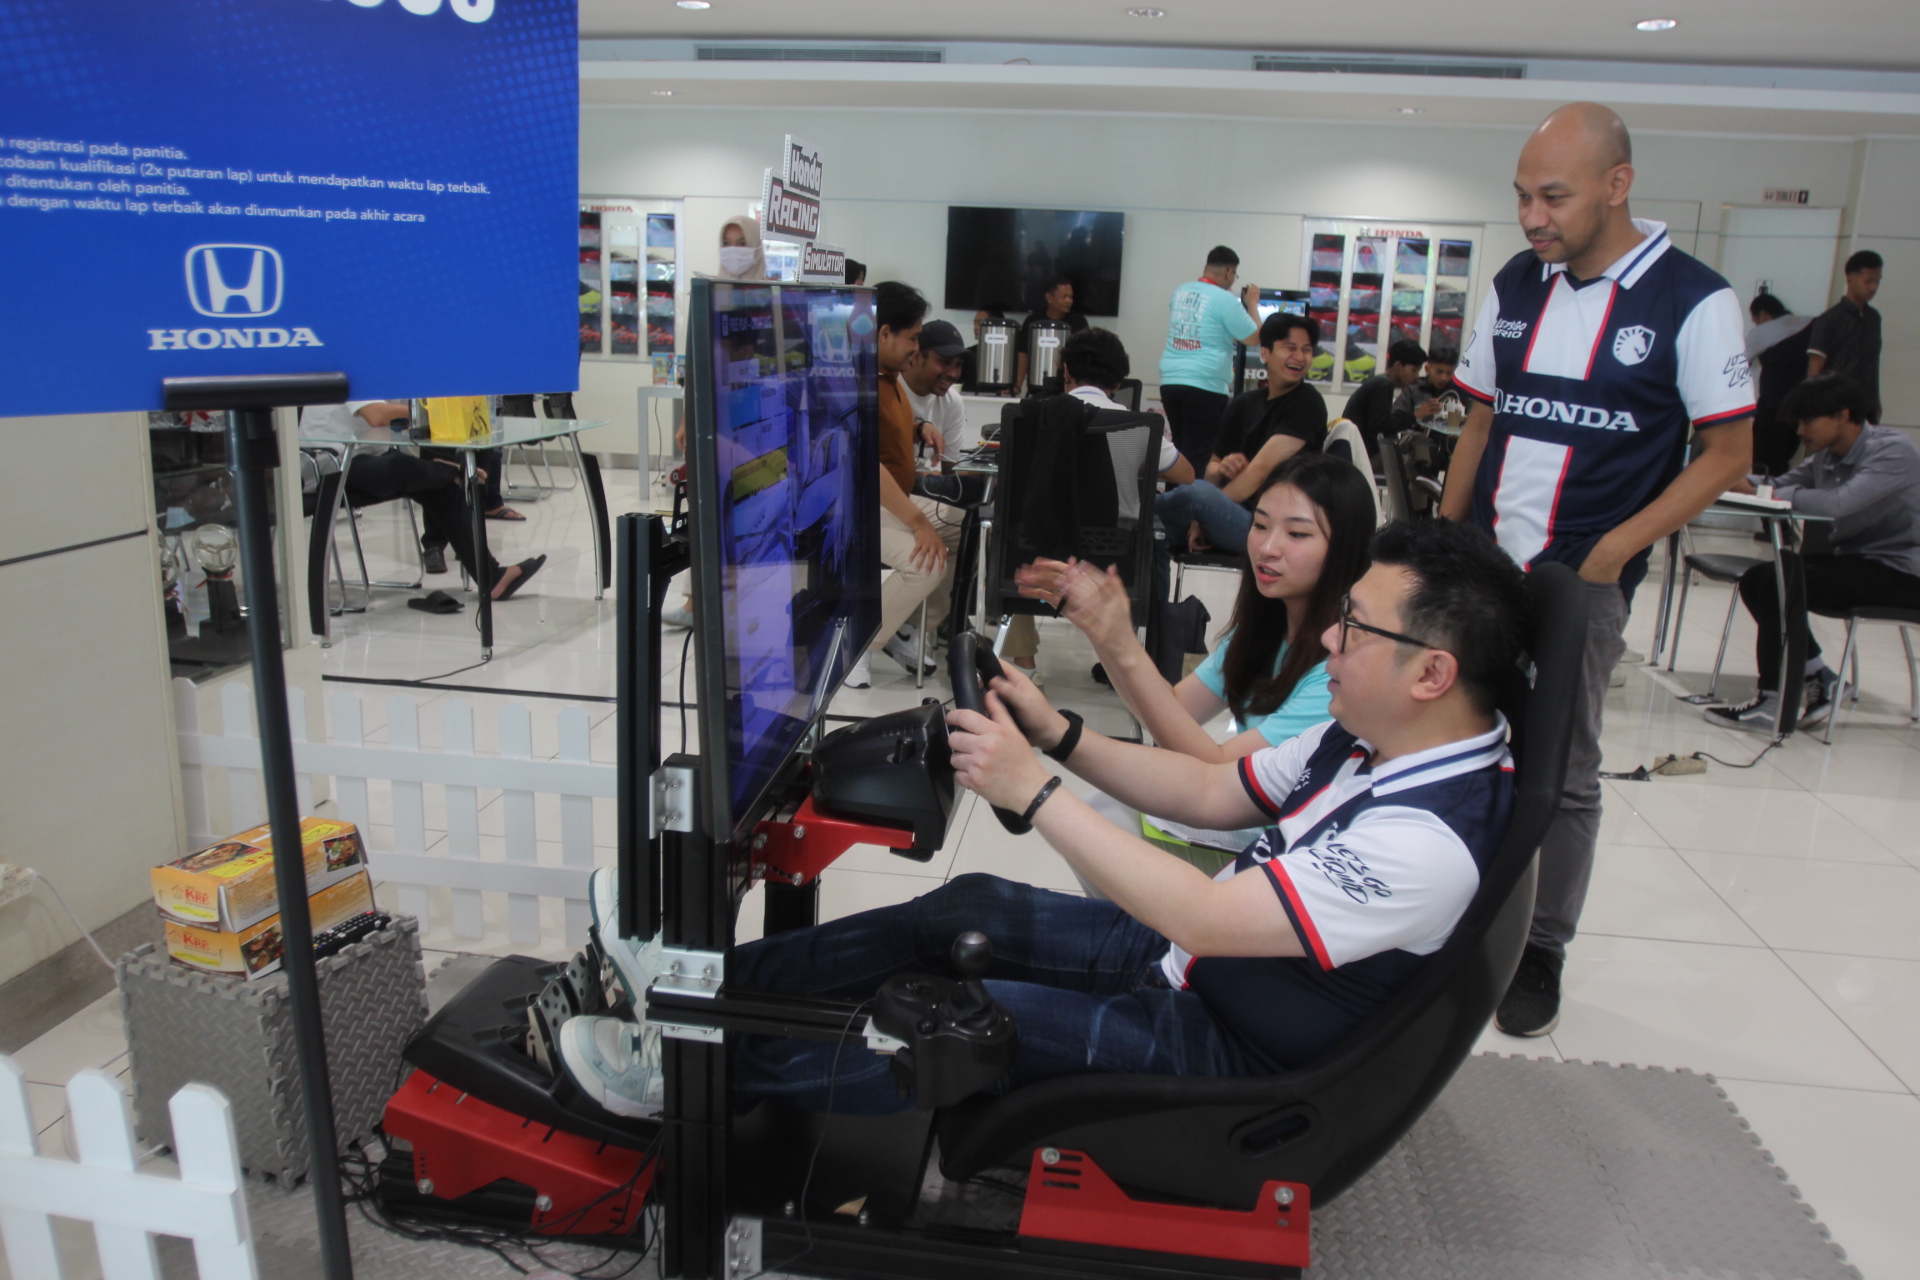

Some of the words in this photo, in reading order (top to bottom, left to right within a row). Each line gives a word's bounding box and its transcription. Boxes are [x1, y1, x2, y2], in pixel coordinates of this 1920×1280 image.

[9, 137, 84, 153] registrasi
[89, 142, 128, 157] pada
[132, 146, 187, 160] panitia.
[60, 157, 135, 174] kualifikasi
[141, 163, 162, 176] (2x
[167, 167, 223, 180] putaran
[226, 167, 252, 184] lap)
[256, 171, 295, 183] untuk
[298, 174, 384, 190] mendapatkan
[387, 178, 424, 190] waktu
[426, 179, 445, 195] lap
[447, 182, 490, 194] terbaik.
[789, 148, 822, 193] Honda
[6, 174, 92, 190] ditentukan
[98, 179, 130, 192] oleh
[135, 183, 189, 196] panitia.
[6, 193, 69, 211] dengan
[73, 197, 121, 210] waktu
[125, 198, 148, 215] lap
[151, 200, 204, 213] terbaik
[207, 202, 241, 215] akan
[244, 203, 322, 218] diumumkan
[325, 208, 357, 222] pada
[360, 209, 390, 220] akhir
[393, 213, 426, 222] acara
[768, 184, 819, 232] RACING
[1375, 229, 1424, 238] HONDA
[804, 246, 845, 272] SIMULATOR
[148, 327, 324, 351] HONDA
[1502, 394, 1640, 432] HONDA
